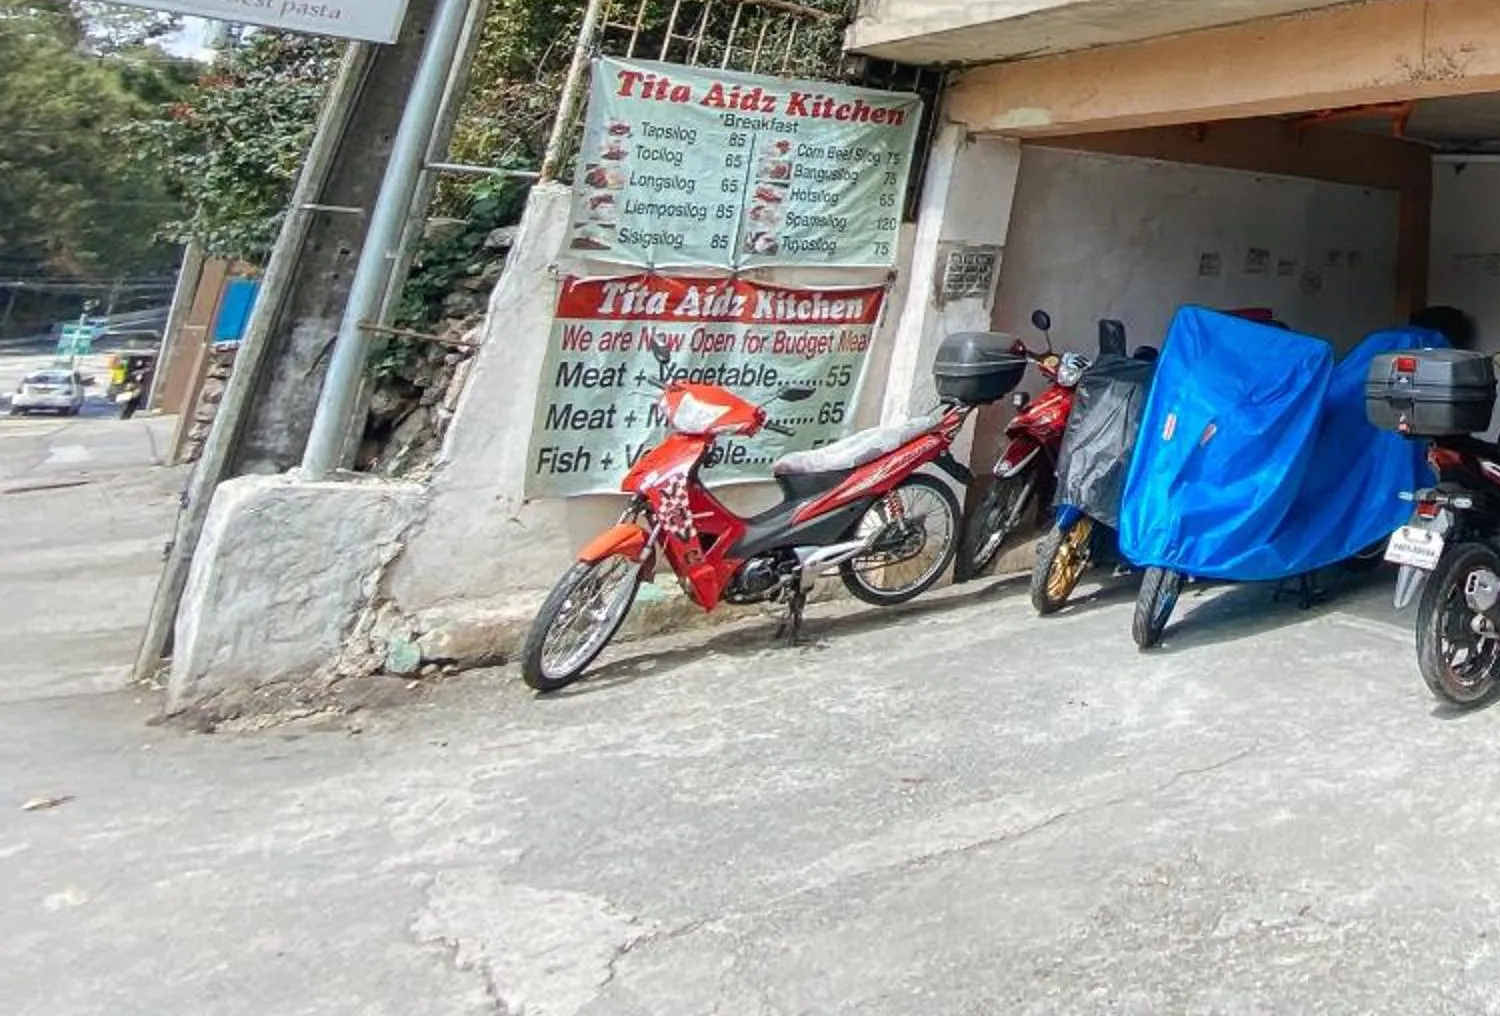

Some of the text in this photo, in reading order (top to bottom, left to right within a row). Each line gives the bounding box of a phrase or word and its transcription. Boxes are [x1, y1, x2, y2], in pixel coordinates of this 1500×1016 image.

[617, 70, 905, 126] Tita Aidz Kitchen
[641, 122, 697, 145] Tapsilog
[636, 145, 684, 167] Tocilog
[629, 171, 696, 194] Longsilog
[623, 199, 735, 221] Liemposilog 85
[617, 227, 685, 249] Sisigsilog
[597, 282, 864, 320] Tita Aidz Kitchen
[561, 325, 593, 351] We
[598, 330, 633, 352] are
[691, 327, 736, 358] Open
[741, 329, 769, 353] for
[772, 330, 834, 360] Budget
[556, 361, 626, 389] Meat
[634, 368, 647, 387] +
[544, 403, 617, 431] Meat
[624, 409, 637, 428] +
[535, 445, 592, 474] Fish
[601, 451, 613, 471] +
